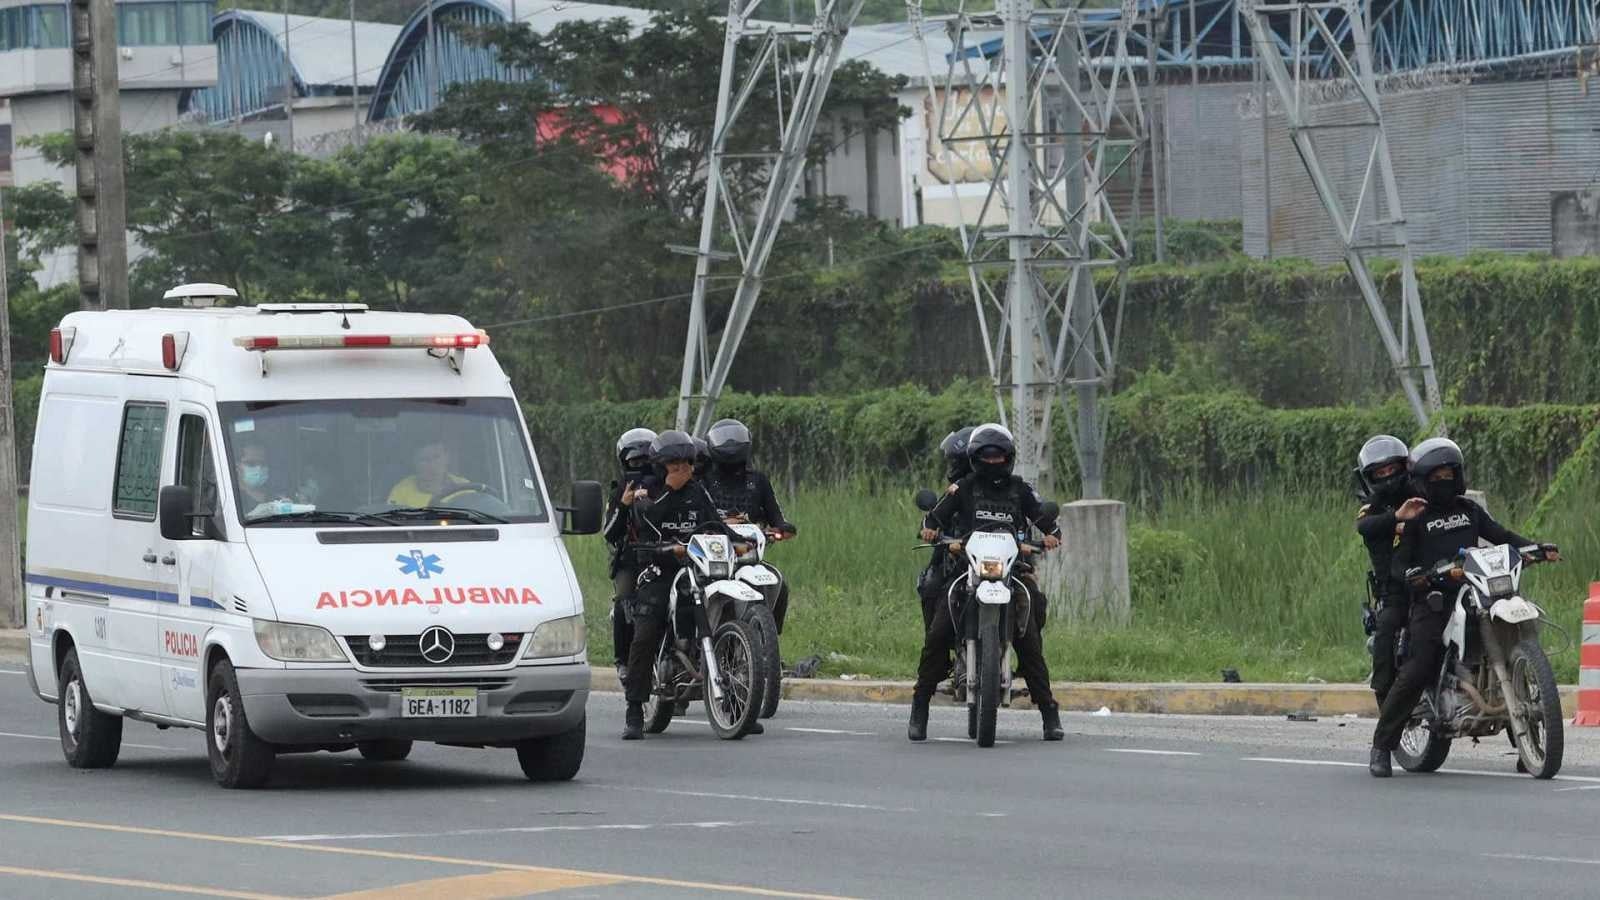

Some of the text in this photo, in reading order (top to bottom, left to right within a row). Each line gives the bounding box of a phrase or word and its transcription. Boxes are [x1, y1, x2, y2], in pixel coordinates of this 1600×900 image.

[975, 510, 1014, 522] POLICIA
[1426, 513, 1471, 532] POLICIA
[165, 630, 198, 657] POLICIA
[408, 699, 471, 715] GEA-1182
